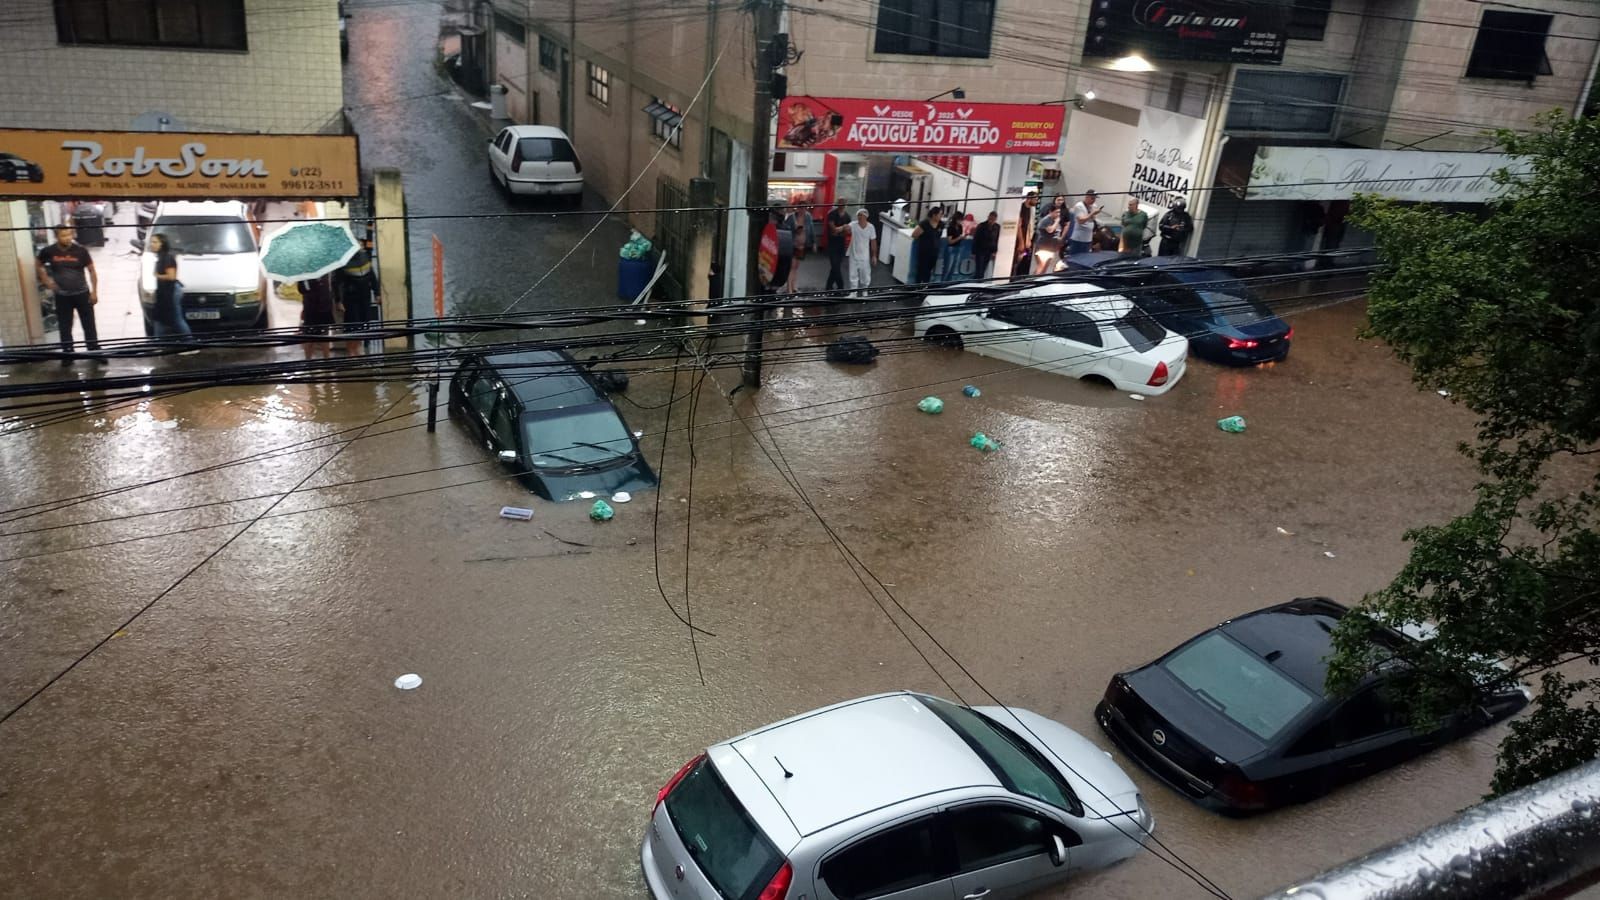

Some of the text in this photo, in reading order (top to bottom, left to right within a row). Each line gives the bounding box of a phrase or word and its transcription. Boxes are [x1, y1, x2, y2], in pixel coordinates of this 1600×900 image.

[891, 110, 913, 118] DESDE
[1012, 121, 1043, 129] DELIVERY
[847, 123, 999, 147] AÇOUGUE DO PRADO
[61, 140, 269, 178] RobSom
[300, 167, 322, 177] (22)
[1132, 163, 1189, 195] PADARIA
[1335, 159, 1417, 192] Padaria
[1419, 162, 1462, 193] Flor
[100, 181, 130, 189] TRAVA
[138, 181, 167, 189] VIDRO
[177, 181, 209, 189] ALARME
